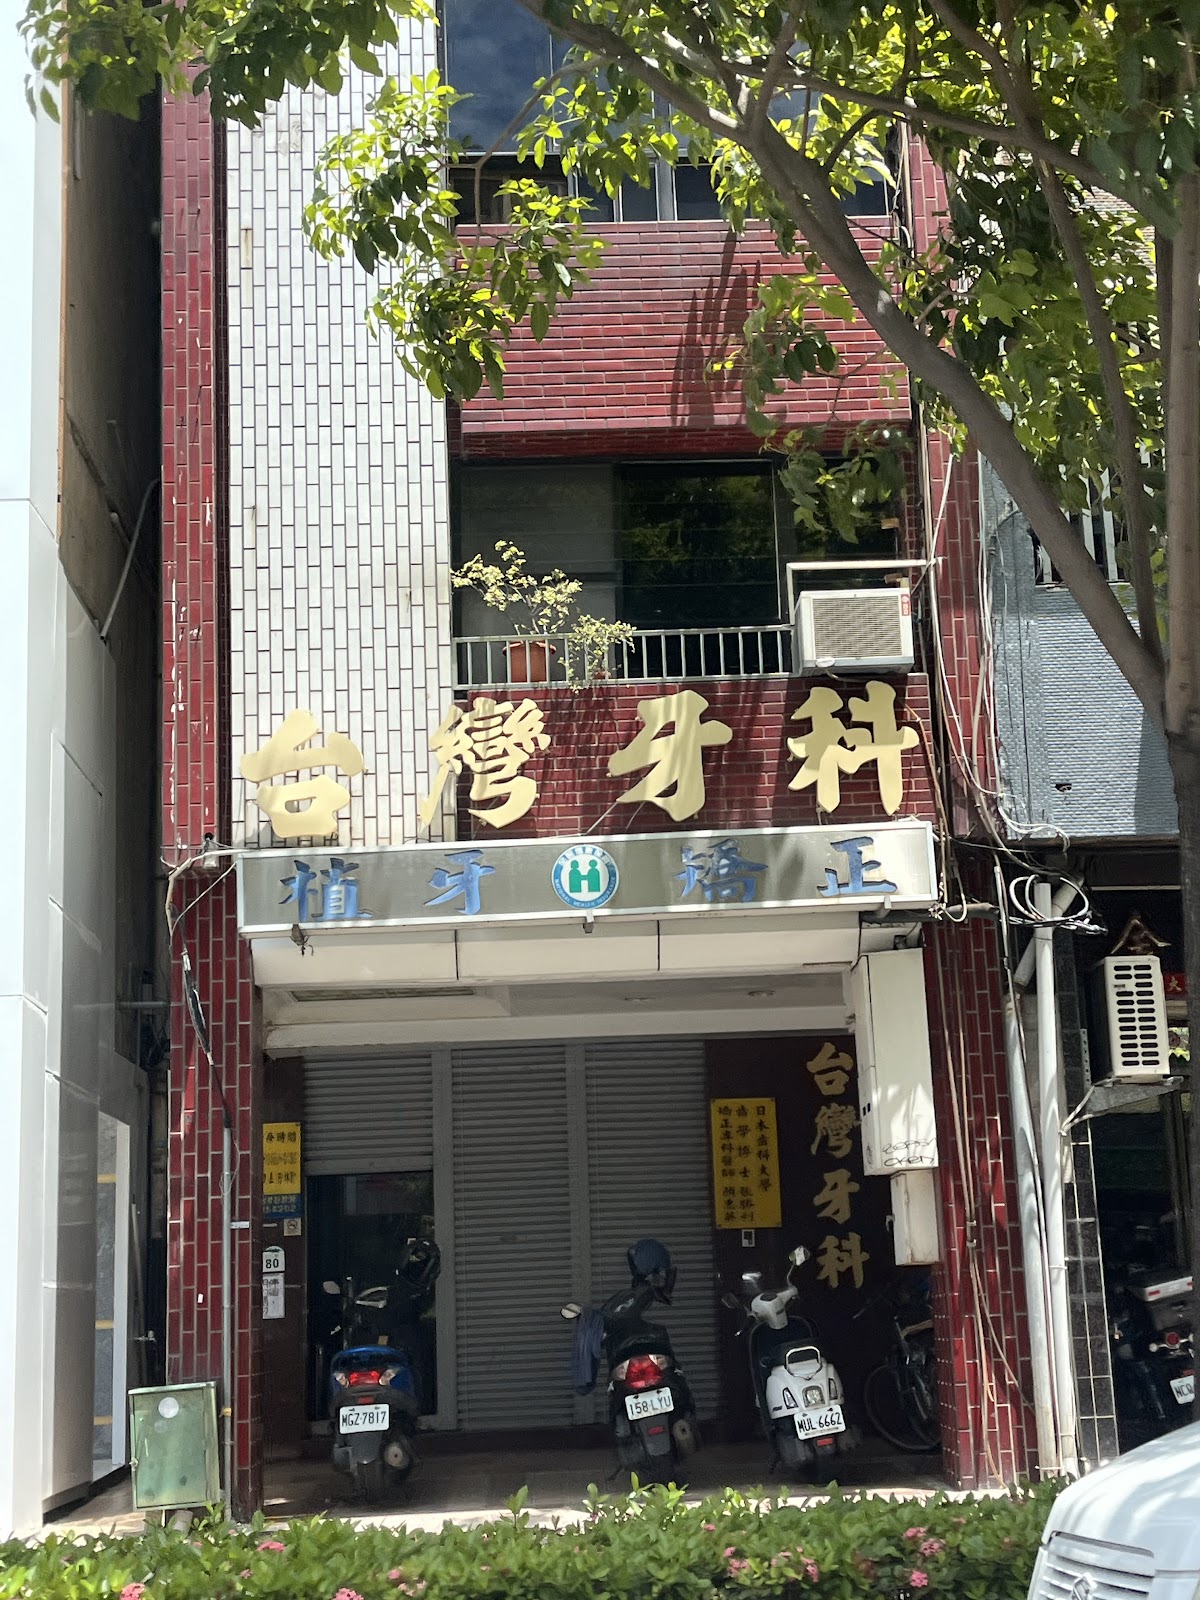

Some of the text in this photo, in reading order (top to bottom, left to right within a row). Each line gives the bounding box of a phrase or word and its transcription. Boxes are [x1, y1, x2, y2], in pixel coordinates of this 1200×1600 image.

[241, 681, 919, 839] 台灣牙科
[279, 849, 497, 922] 植牙
[674, 837, 898, 903] 矯正
[806, 1042, 871, 1289] 台灣牙科
[265, 1258, 279, 1269] 80
[341, 1410, 387, 1427] MGZ-7817
[797, 1411, 843, 1434] MUL-6662
